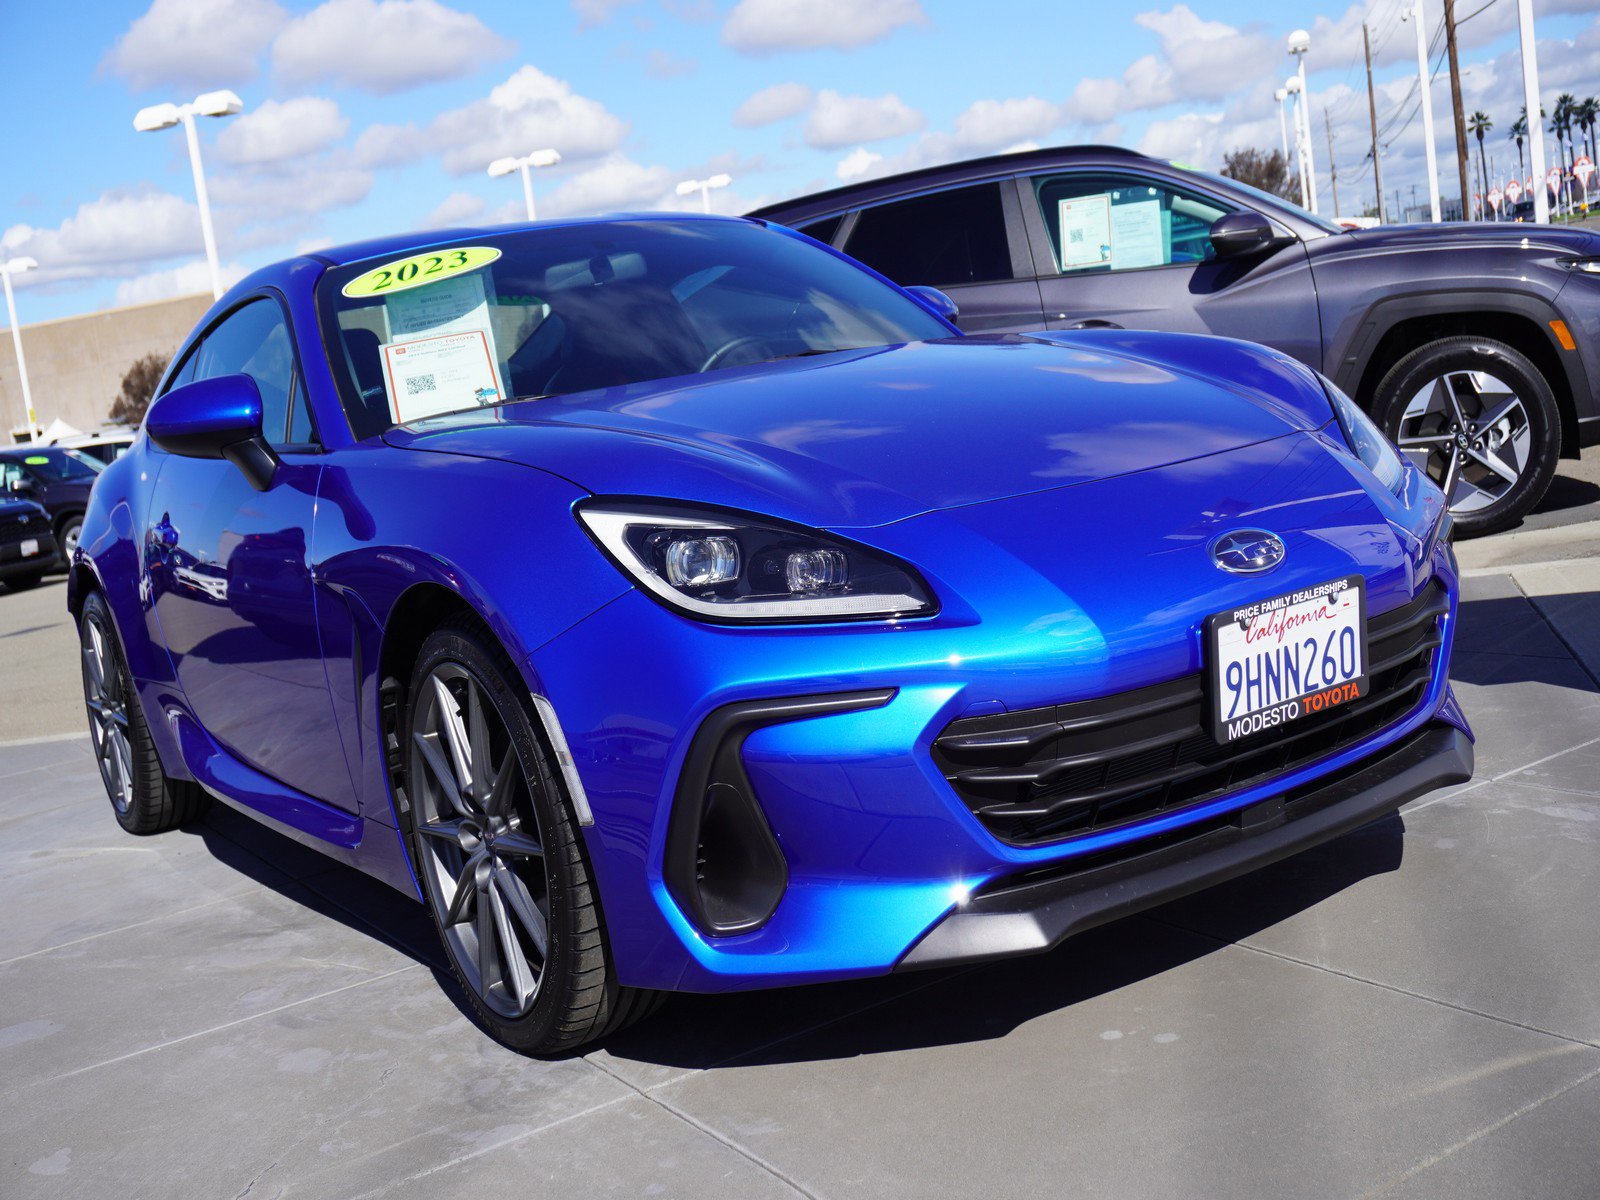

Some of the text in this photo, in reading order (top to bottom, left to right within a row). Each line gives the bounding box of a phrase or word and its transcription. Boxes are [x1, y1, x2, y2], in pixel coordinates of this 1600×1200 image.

[372, 251, 468, 291] 2023
[1234, 579, 1348, 622] PRICE FAMILY DEALERSHIPS
[1245, 603, 1337, 644] California
[1225, 626, 1356, 719] 9HNN260
[1228, 682, 1360, 741] MODESTO TOYOTA
